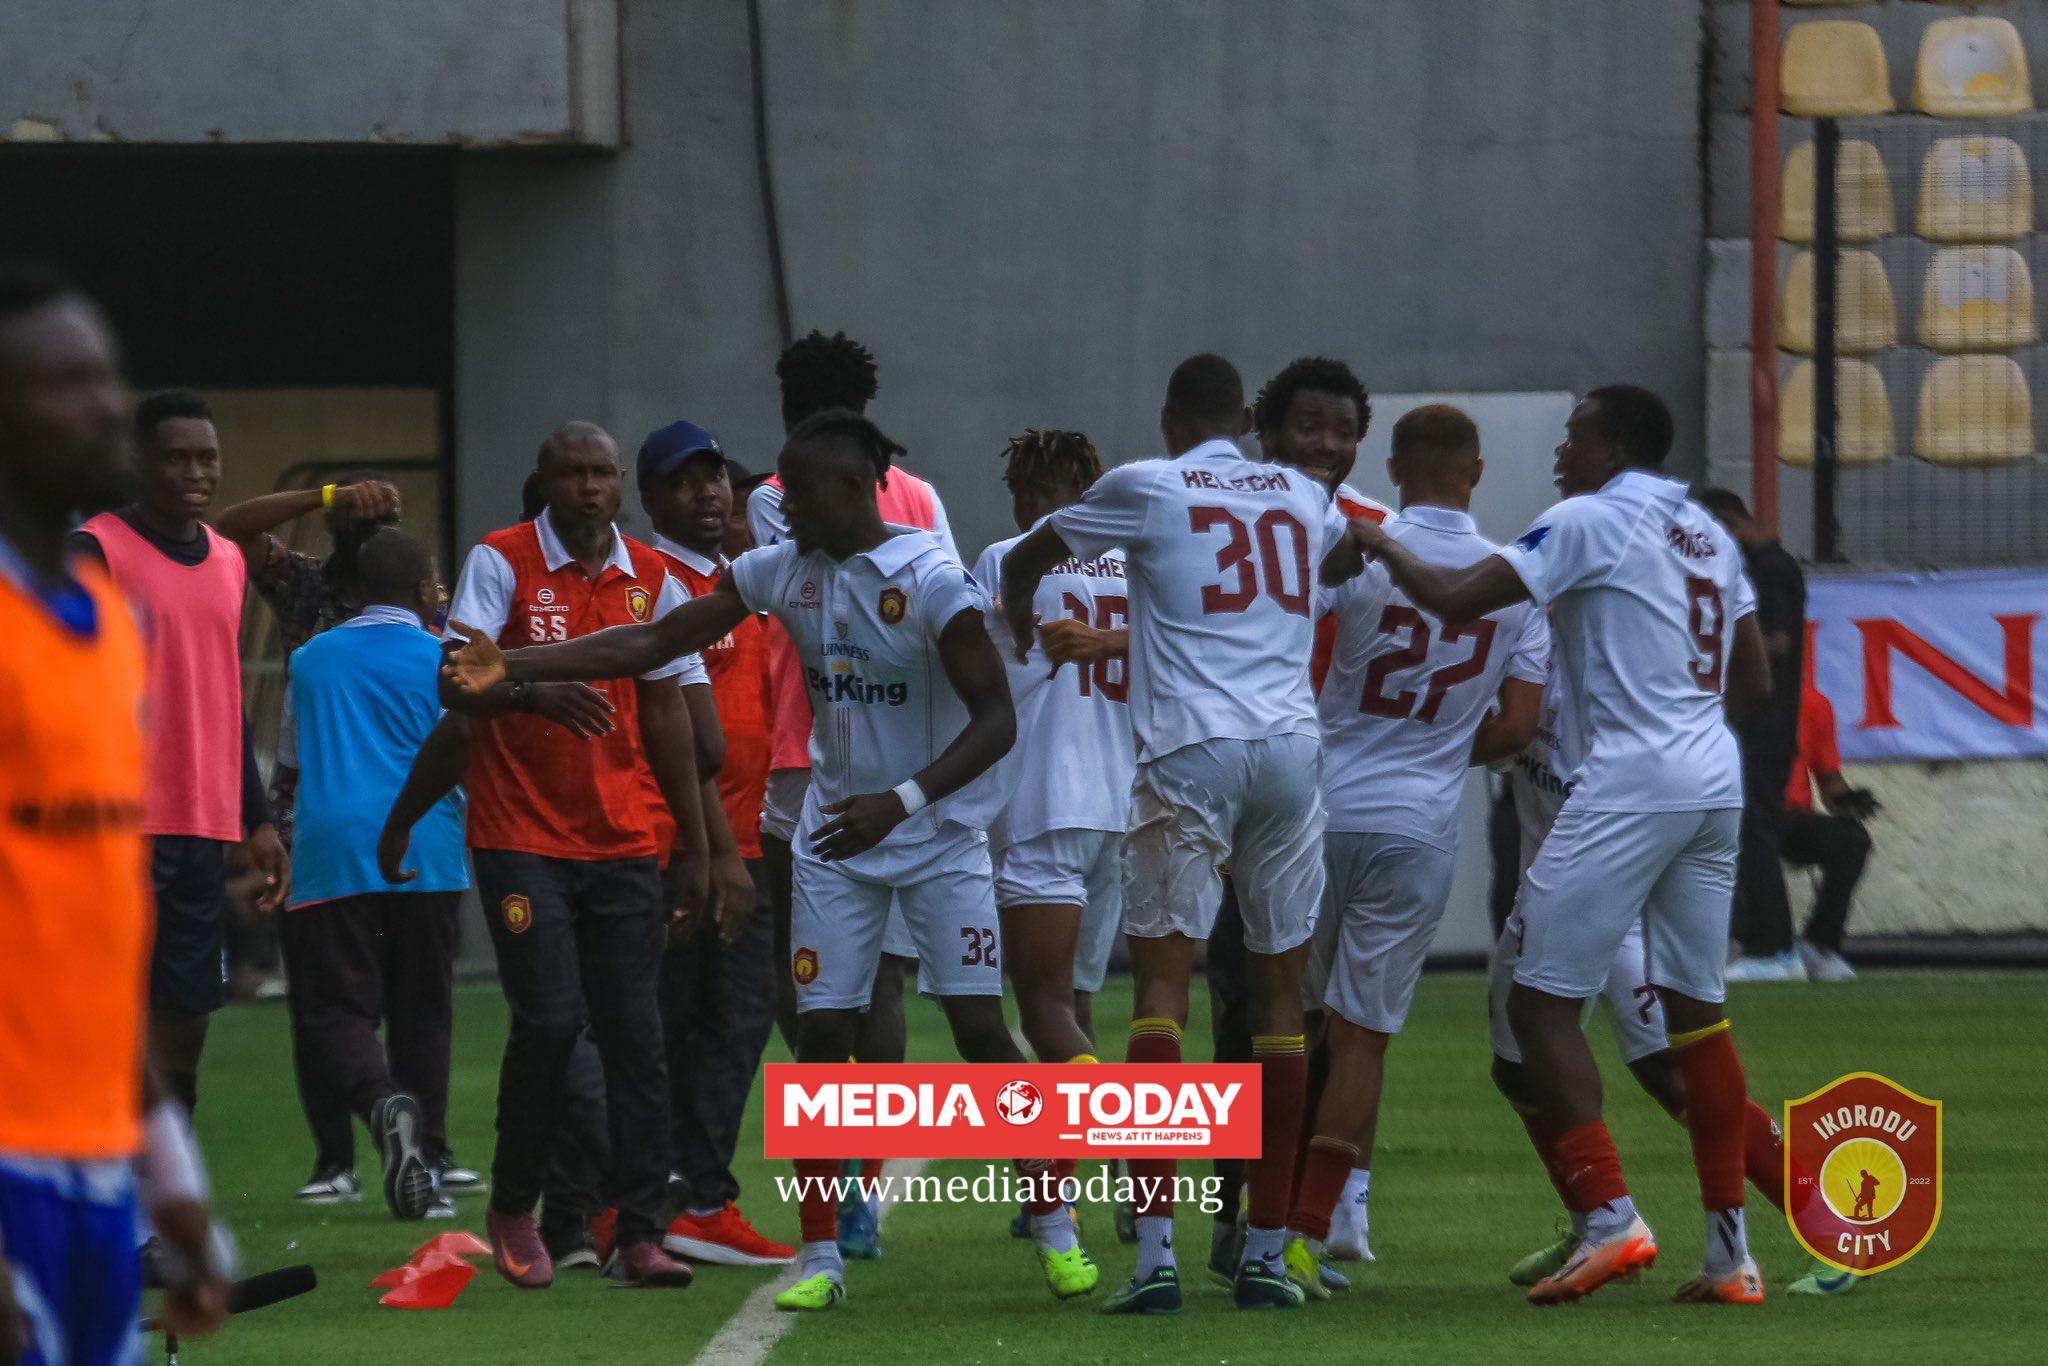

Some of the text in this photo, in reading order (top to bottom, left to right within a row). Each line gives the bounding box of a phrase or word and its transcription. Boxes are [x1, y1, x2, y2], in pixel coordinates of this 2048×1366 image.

[1187, 506, 1310, 619] 30
[530, 615, 568, 642] S.S
[1359, 604, 1498, 725] 27
[1685, 576, 1724, 694] 9
[960, 926, 998, 969] 32
